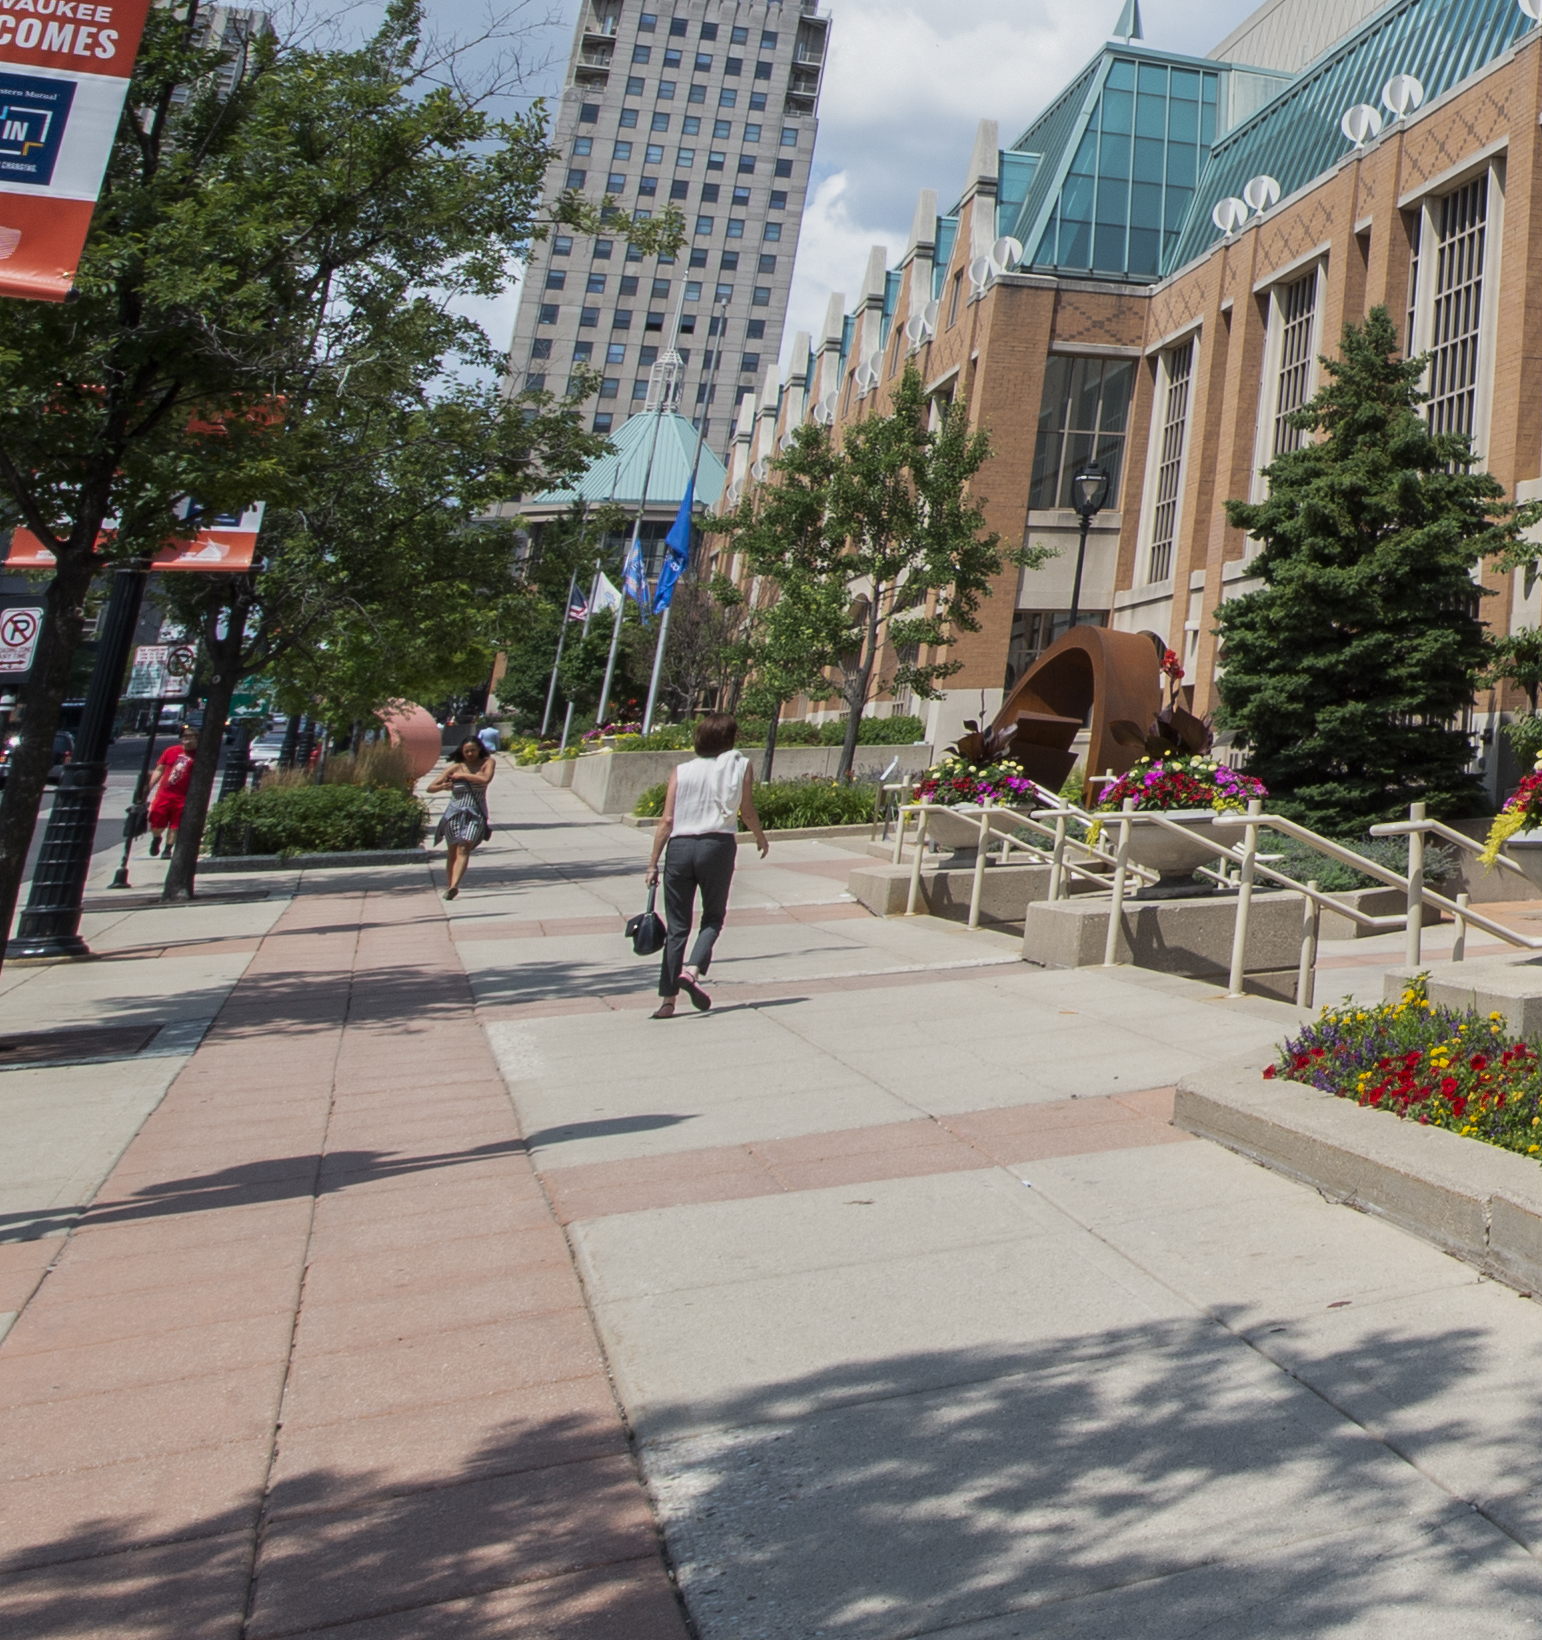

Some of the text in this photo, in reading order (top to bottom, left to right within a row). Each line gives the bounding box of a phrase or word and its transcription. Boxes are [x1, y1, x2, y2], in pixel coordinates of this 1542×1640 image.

[0, 13, 120, 60] COMES
[25, 89, 58, 101] Mutual
[2, 120, 29, 142] IN
